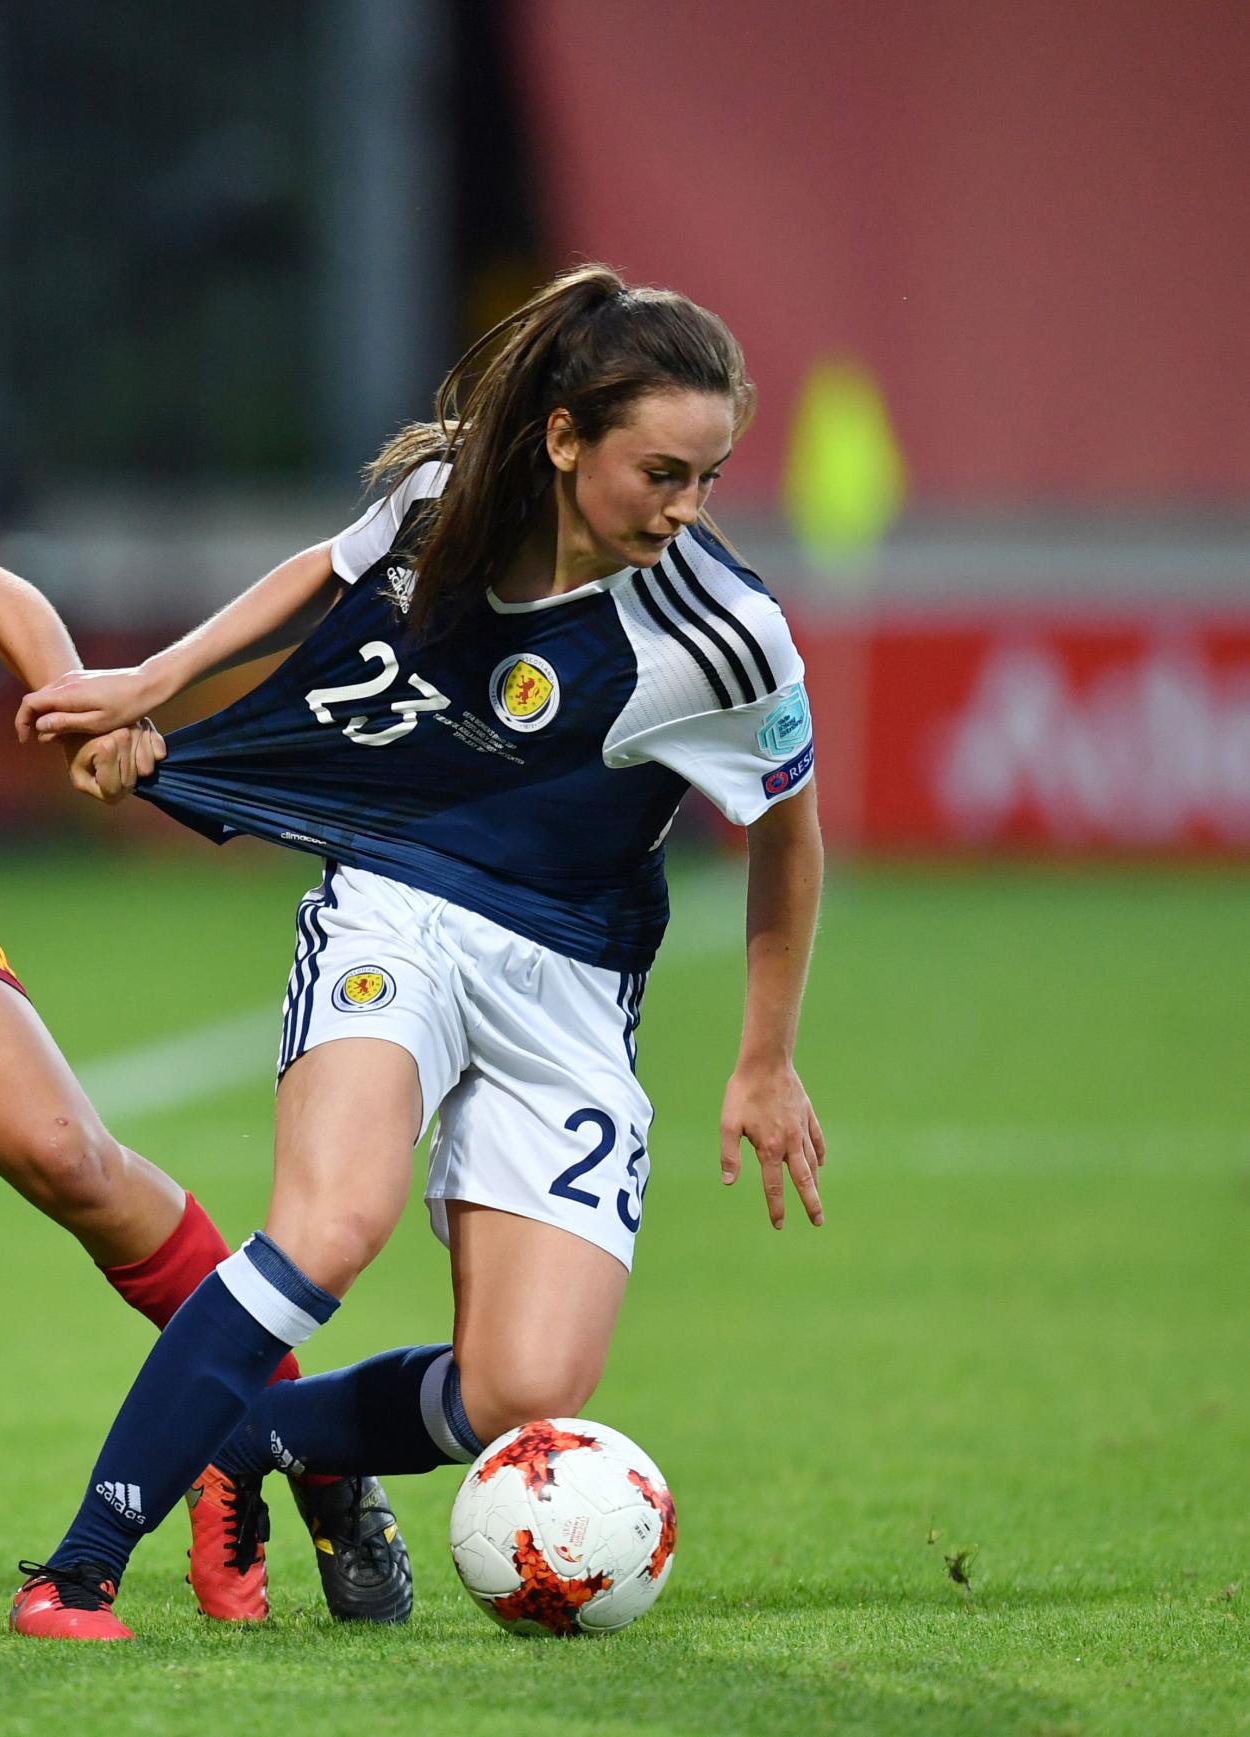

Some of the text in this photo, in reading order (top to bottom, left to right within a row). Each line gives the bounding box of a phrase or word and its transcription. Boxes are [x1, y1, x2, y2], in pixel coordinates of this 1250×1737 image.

[305, 641, 451, 746] 23
[524, 657, 555, 682] SCOTLAND
[548, 1108, 641, 1233] 23
[96, 1484, 146, 1525] adidas
